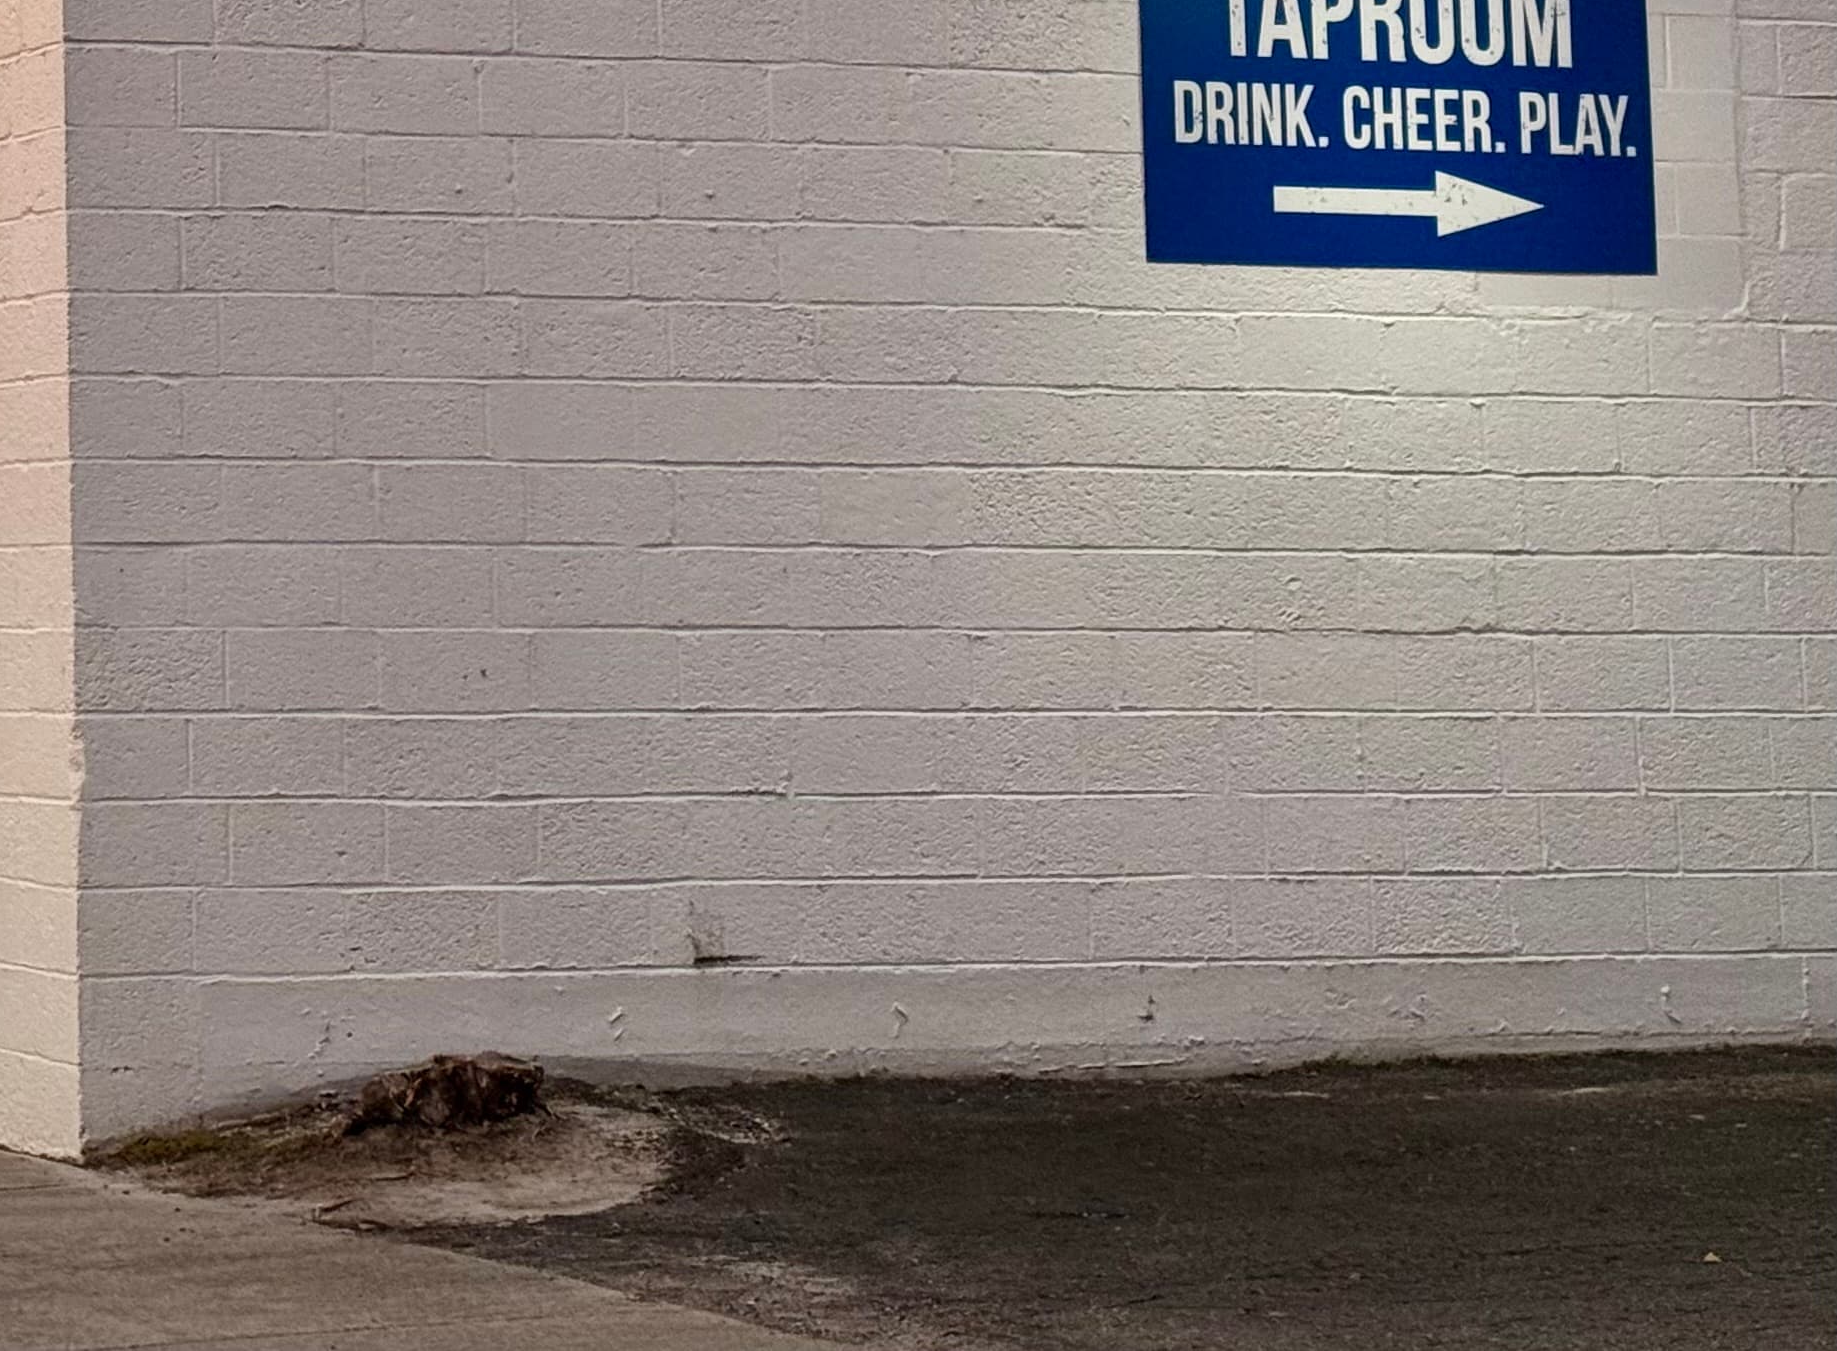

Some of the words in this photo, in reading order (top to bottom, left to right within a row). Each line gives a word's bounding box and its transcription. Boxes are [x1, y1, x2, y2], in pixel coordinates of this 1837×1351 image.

[1173, 80, 1329, 148] DRINK.
[1343, 86, 1506, 154] CHEER.
[1520, 92, 1637, 158] PLAY.
